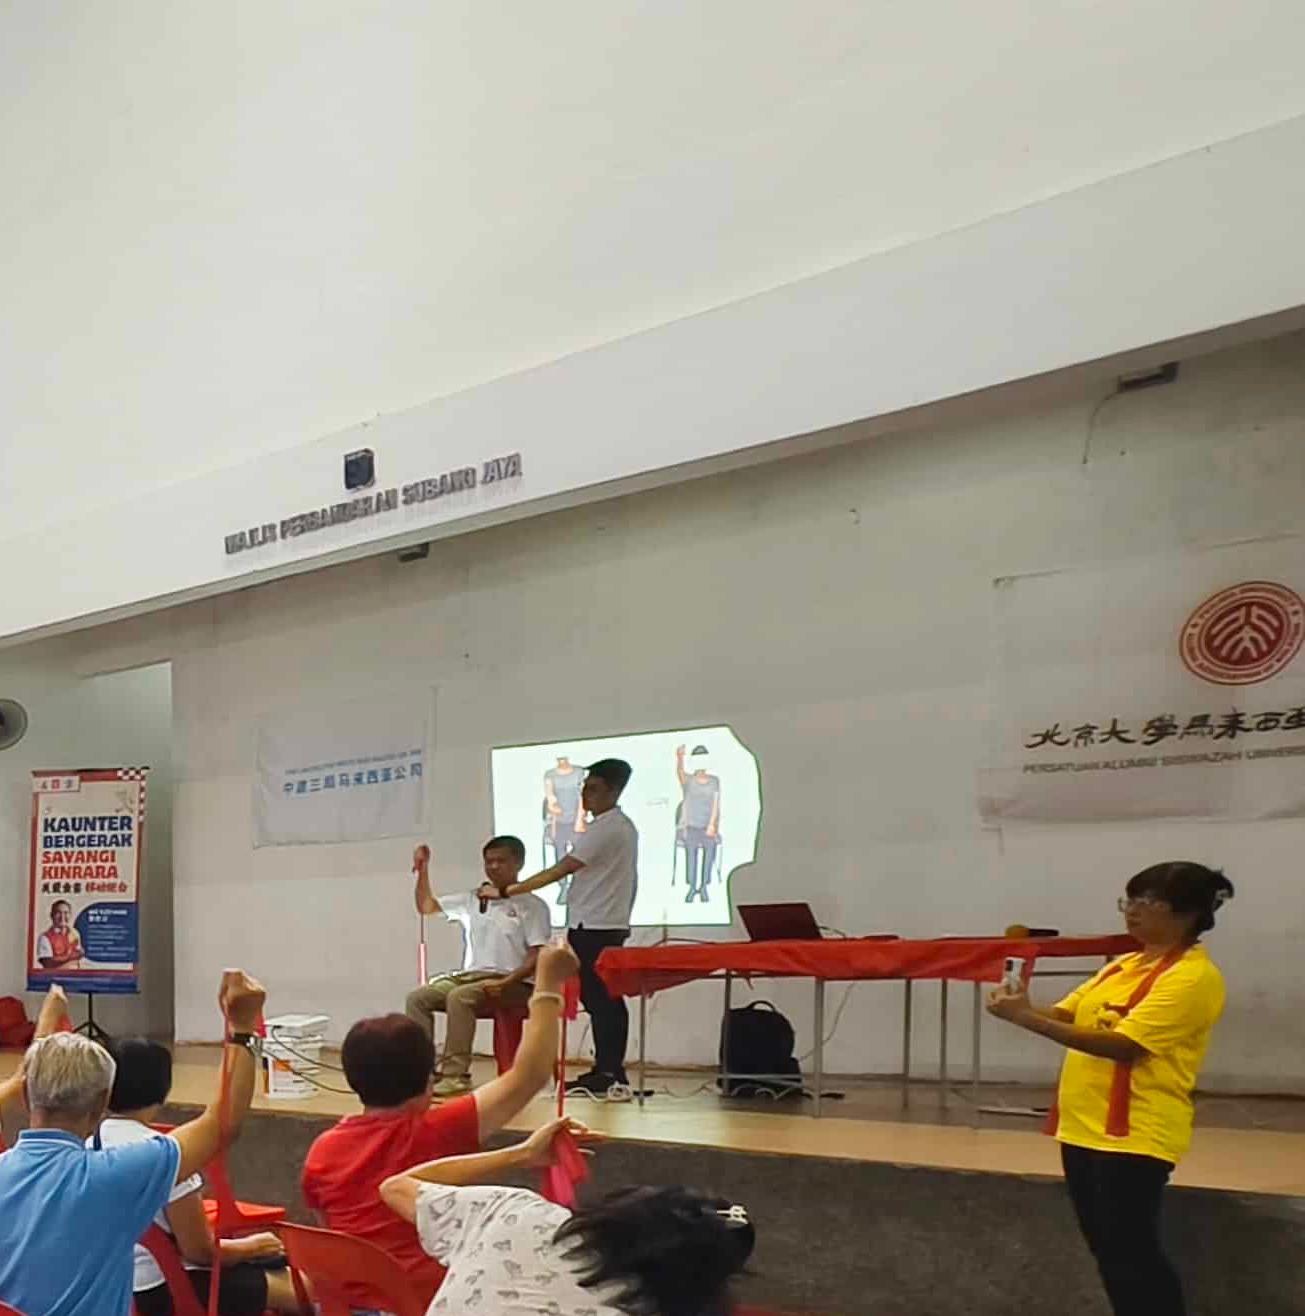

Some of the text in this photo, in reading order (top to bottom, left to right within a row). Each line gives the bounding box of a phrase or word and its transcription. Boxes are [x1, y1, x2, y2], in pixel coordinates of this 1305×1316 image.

[402, 468, 476, 505] SUBANG
[481, 453, 522, 483] JAYA
[43, 815, 133, 833] KAUNTER
[43, 833, 133, 849] BERGERAK
[41, 850, 116, 864] SAYANGI
[41, 864, 118, 880] KINRARA
